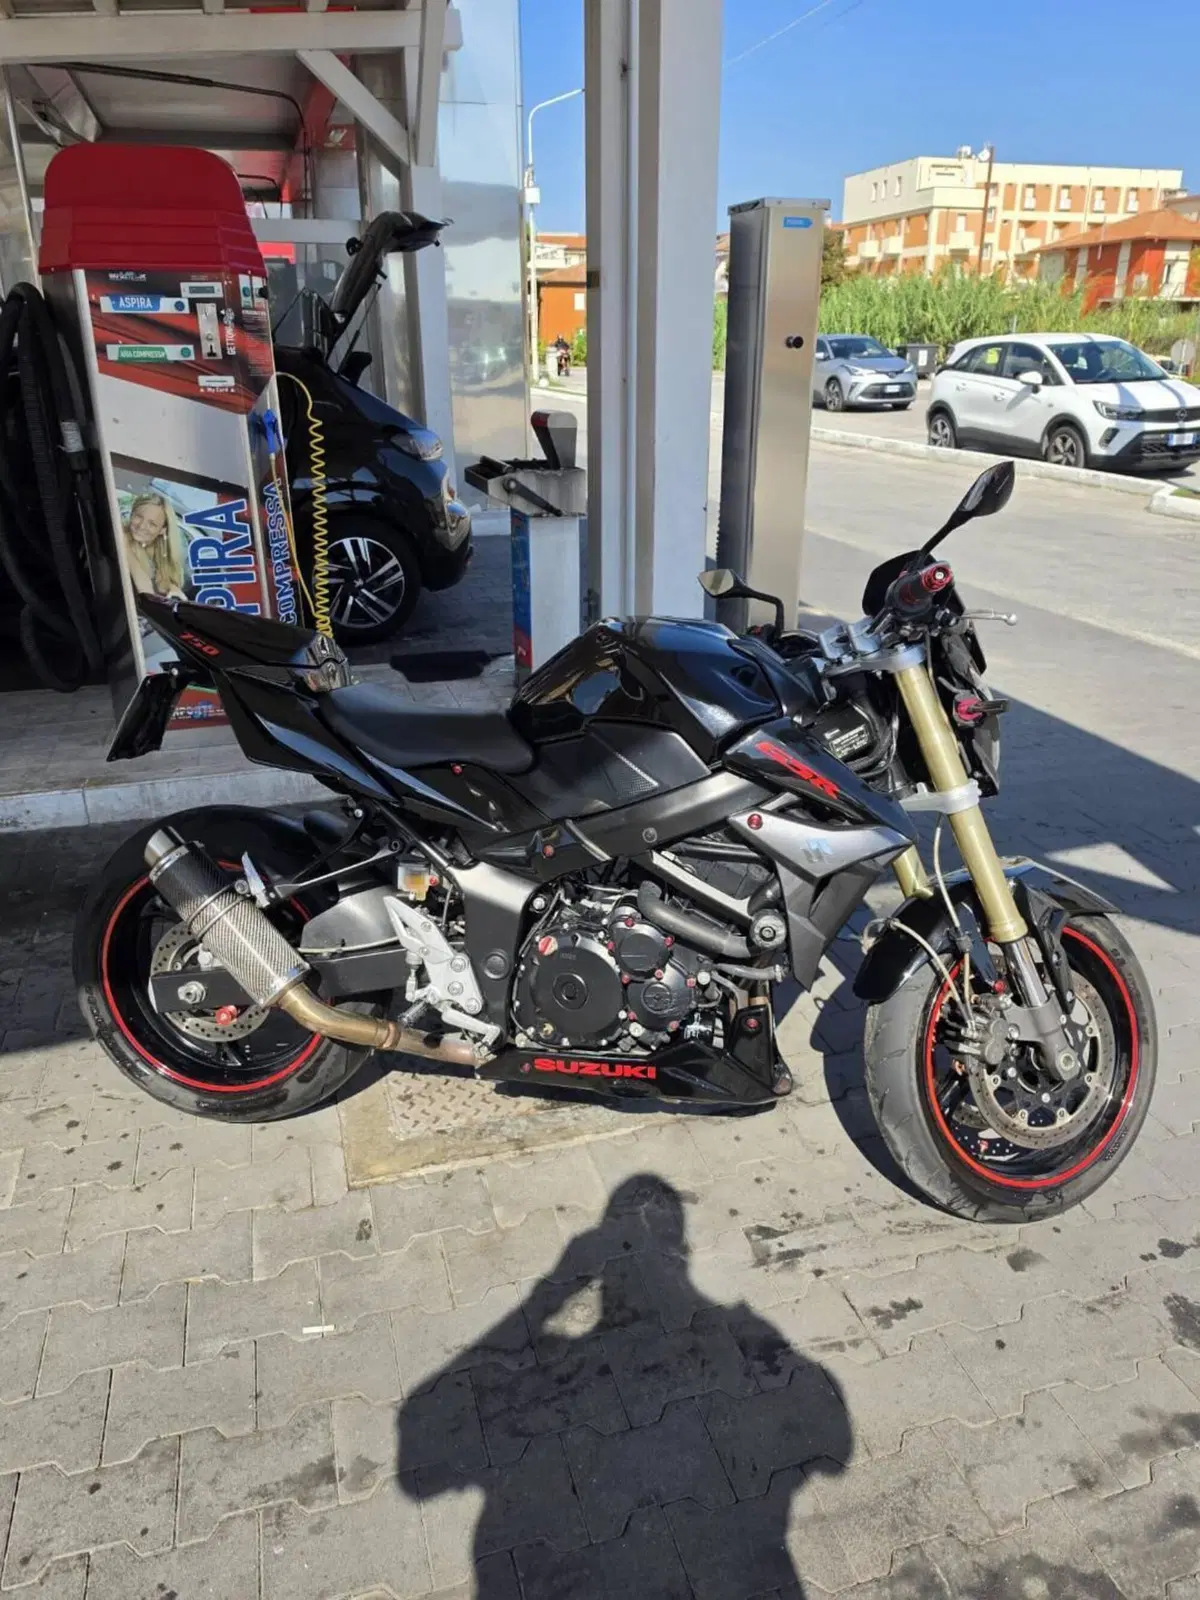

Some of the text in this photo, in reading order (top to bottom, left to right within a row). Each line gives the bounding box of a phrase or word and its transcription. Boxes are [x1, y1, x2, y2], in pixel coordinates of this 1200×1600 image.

[119, 296, 153, 309] ASPIRA
[263, 478, 298, 626] COMPRESSA
[534, 1058, 657, 1080] SUZUKI
